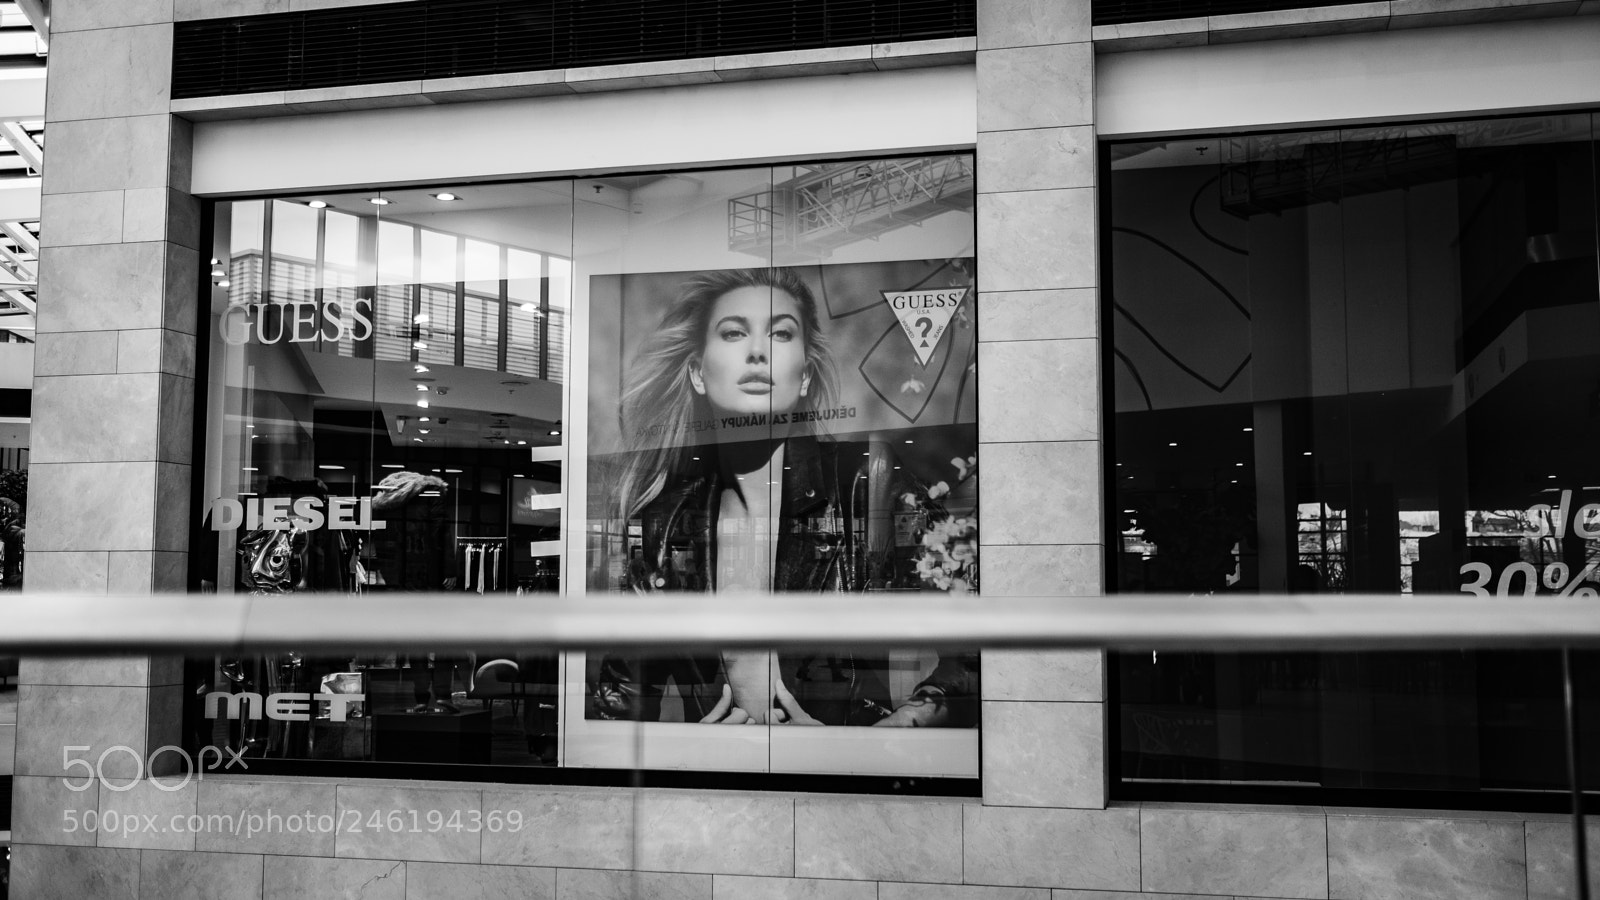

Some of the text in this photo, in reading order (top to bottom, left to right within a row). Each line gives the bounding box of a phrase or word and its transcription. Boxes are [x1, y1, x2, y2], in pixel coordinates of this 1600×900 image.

[893, 293, 958, 310] GUESS
[219, 298, 373, 345] GUESS
[933, 325, 944, 340] JEANS
[211, 496, 387, 531] DIESEL
[1459, 561, 1600, 598] 30%
[204, 691, 366, 722] MET
